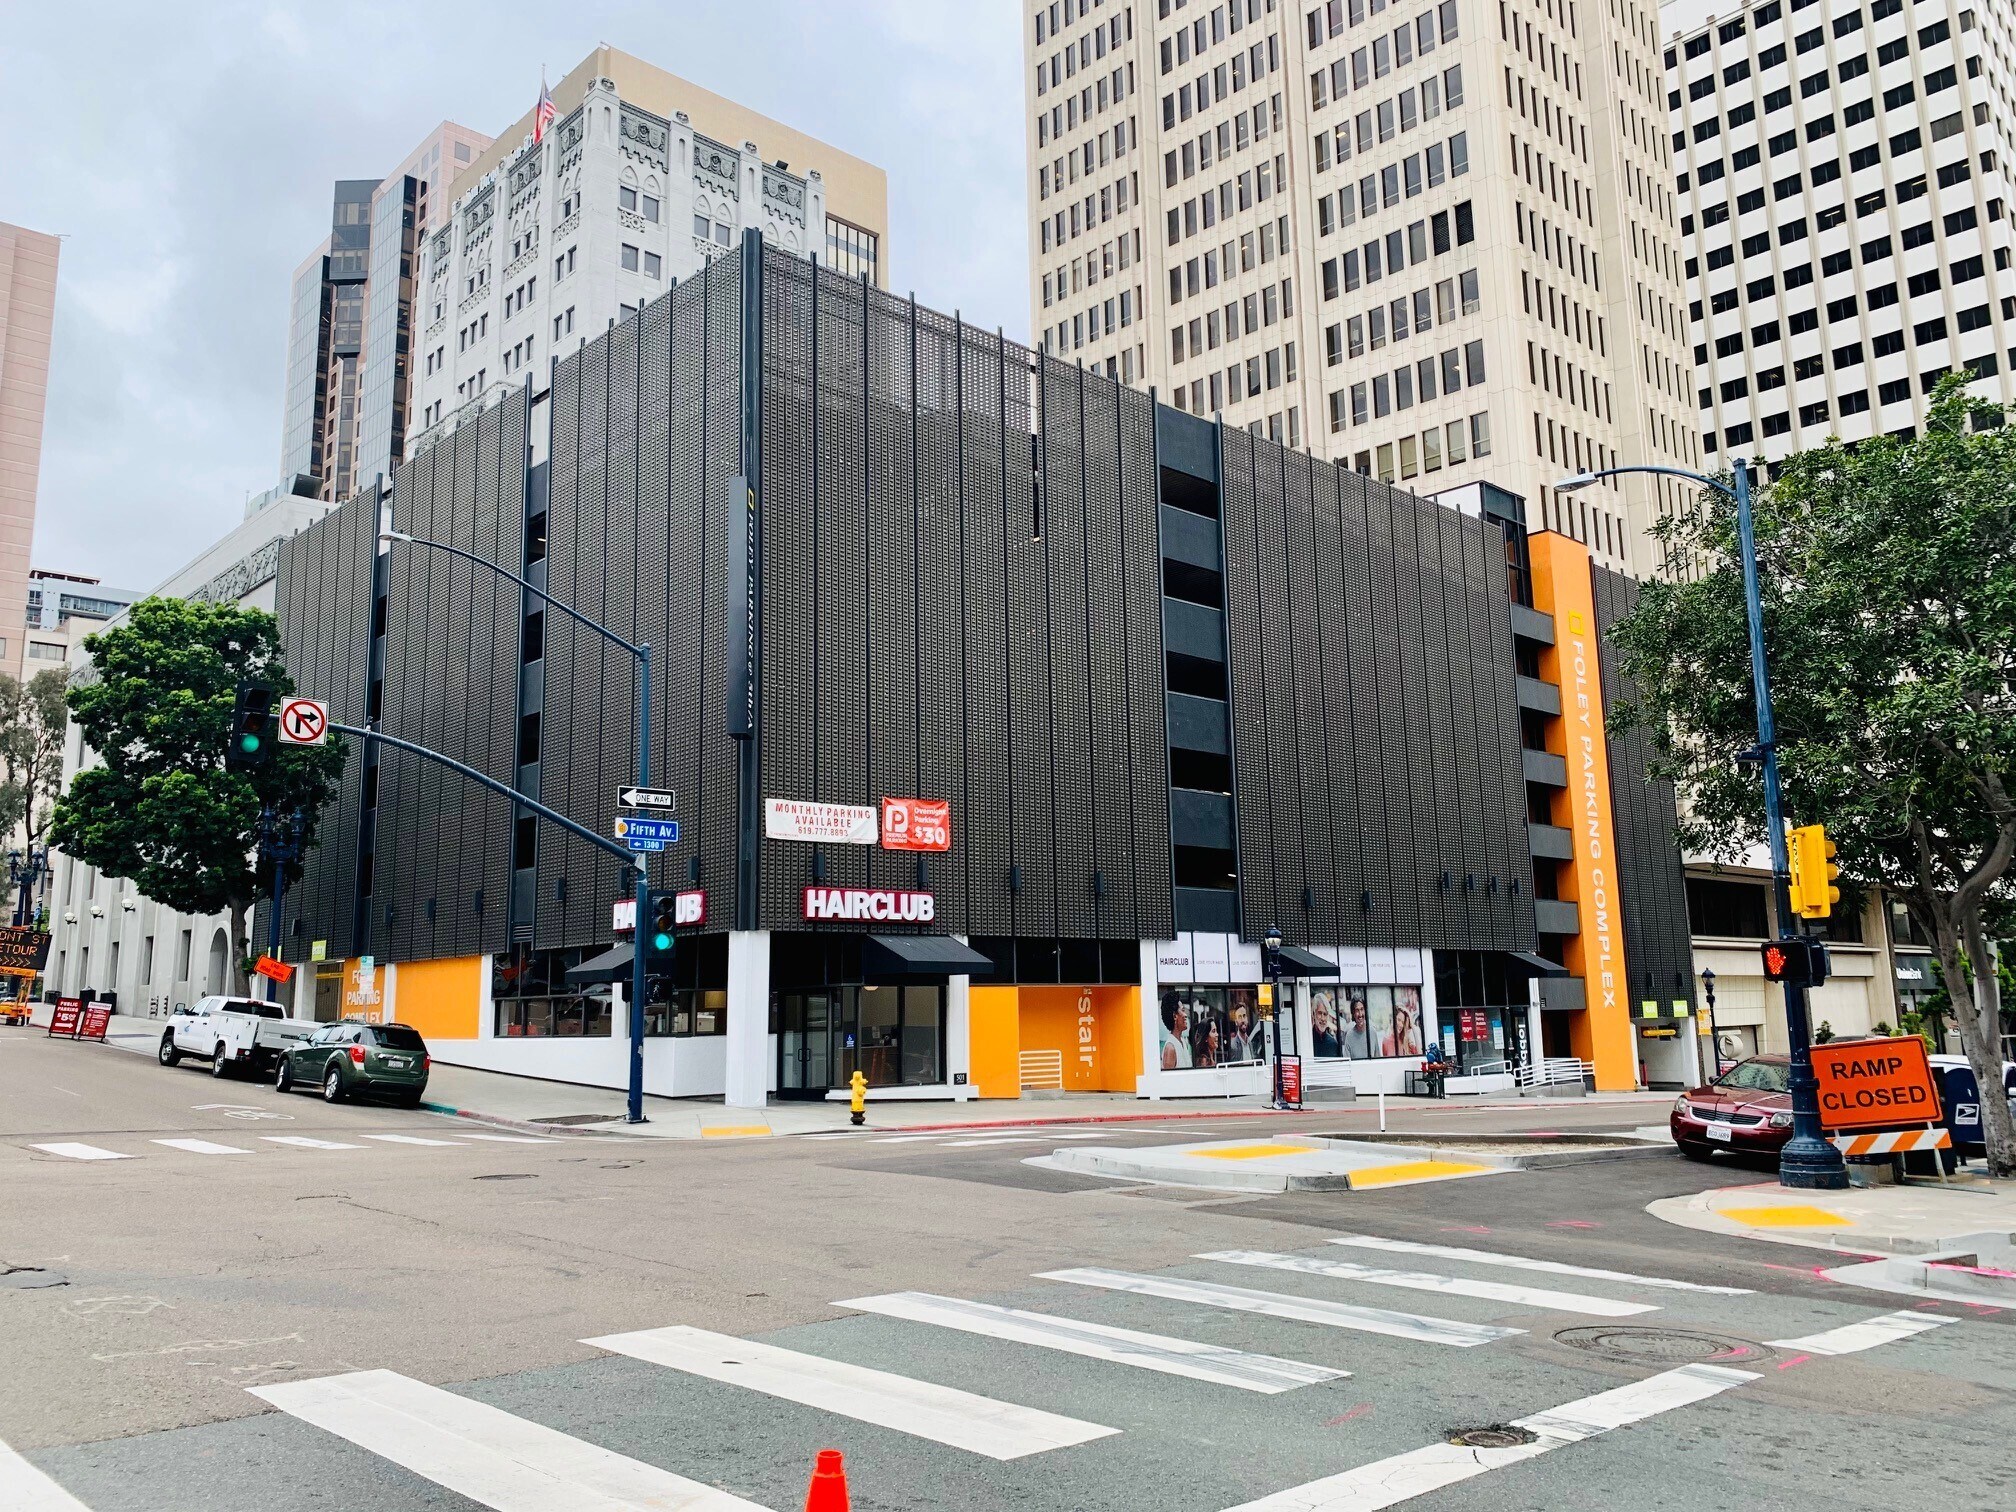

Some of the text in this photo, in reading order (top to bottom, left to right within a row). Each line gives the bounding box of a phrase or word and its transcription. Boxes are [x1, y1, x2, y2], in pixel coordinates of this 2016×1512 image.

[635, 793, 669, 804] ONE WAY
[775, 803, 871, 819] MONTHLY PARKING
[914, 807, 947, 816] Overnight
[795, 815, 852, 828] AVAILABLE
[914, 815, 940, 825] Parking
[1572, 641, 1616, 1009] FOLEY PARKING COMPLEX
[798, 826, 849, 837] 619.777.8893
[914, 826, 946, 845] $30
[643, 840, 660, 849] 1300
[613, 894, 703, 930] HAUB
[806, 889, 935, 921] HAIRCLUB
[31, 934, 48, 945] ST
[1159, 957, 1189, 966] HAIRCLUB
[1078, 996, 1097, 1068] stair
[1518, 1024, 1528, 1070] lobby
[1830, 1057, 1903, 1080] RAMP
[1822, 1085, 1927, 1111] CLOSED
